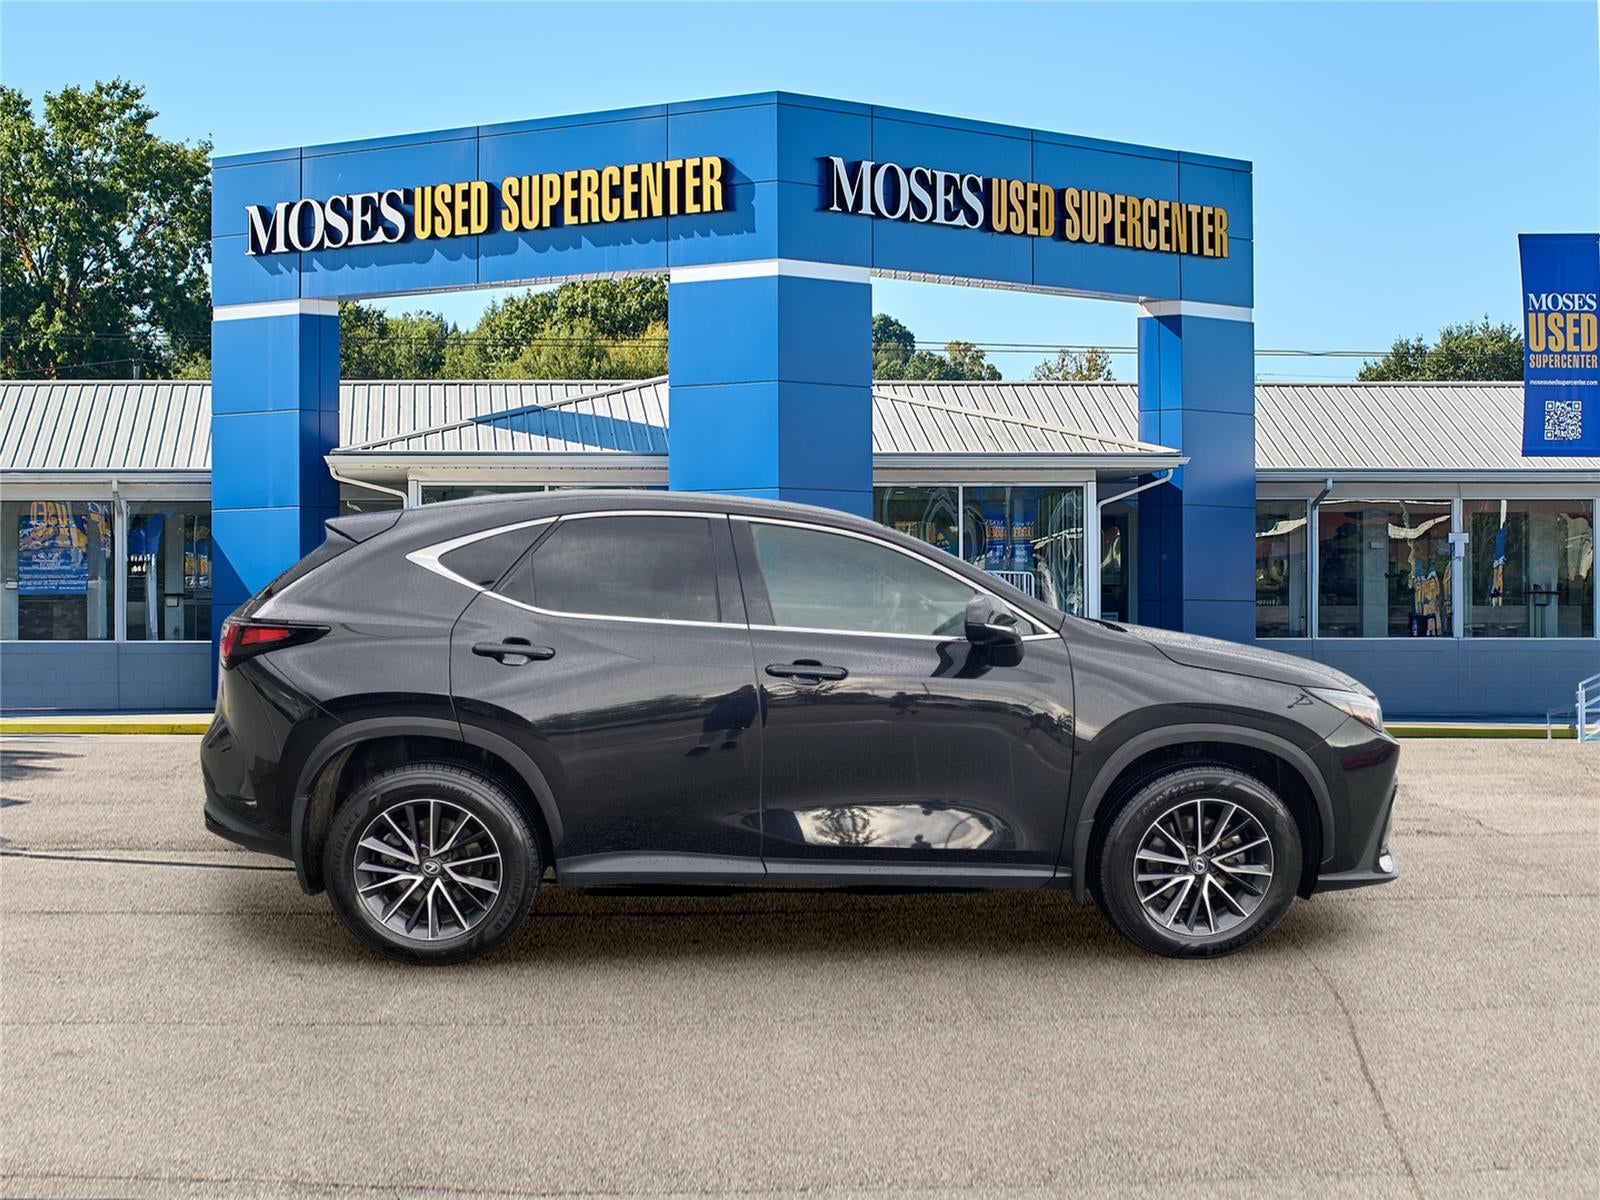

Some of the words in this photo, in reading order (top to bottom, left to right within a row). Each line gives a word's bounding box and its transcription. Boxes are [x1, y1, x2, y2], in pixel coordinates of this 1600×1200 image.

[244, 190, 407, 256] MOSES
[413, 180, 489, 240] USED
[501, 156, 724, 232] SUPERCENTER
[828, 155, 985, 230] MOSES
[991, 178, 1055, 237] USED
[1065, 187, 1229, 258] SUPERCENTER
[1527, 292, 1597, 312] MOSES
[1528, 312, 1598, 352] USED
[1529, 353, 1598, 369] SUPERCENTER
[1529, 379, 1598, 387] mosesusedsupercenter.com
